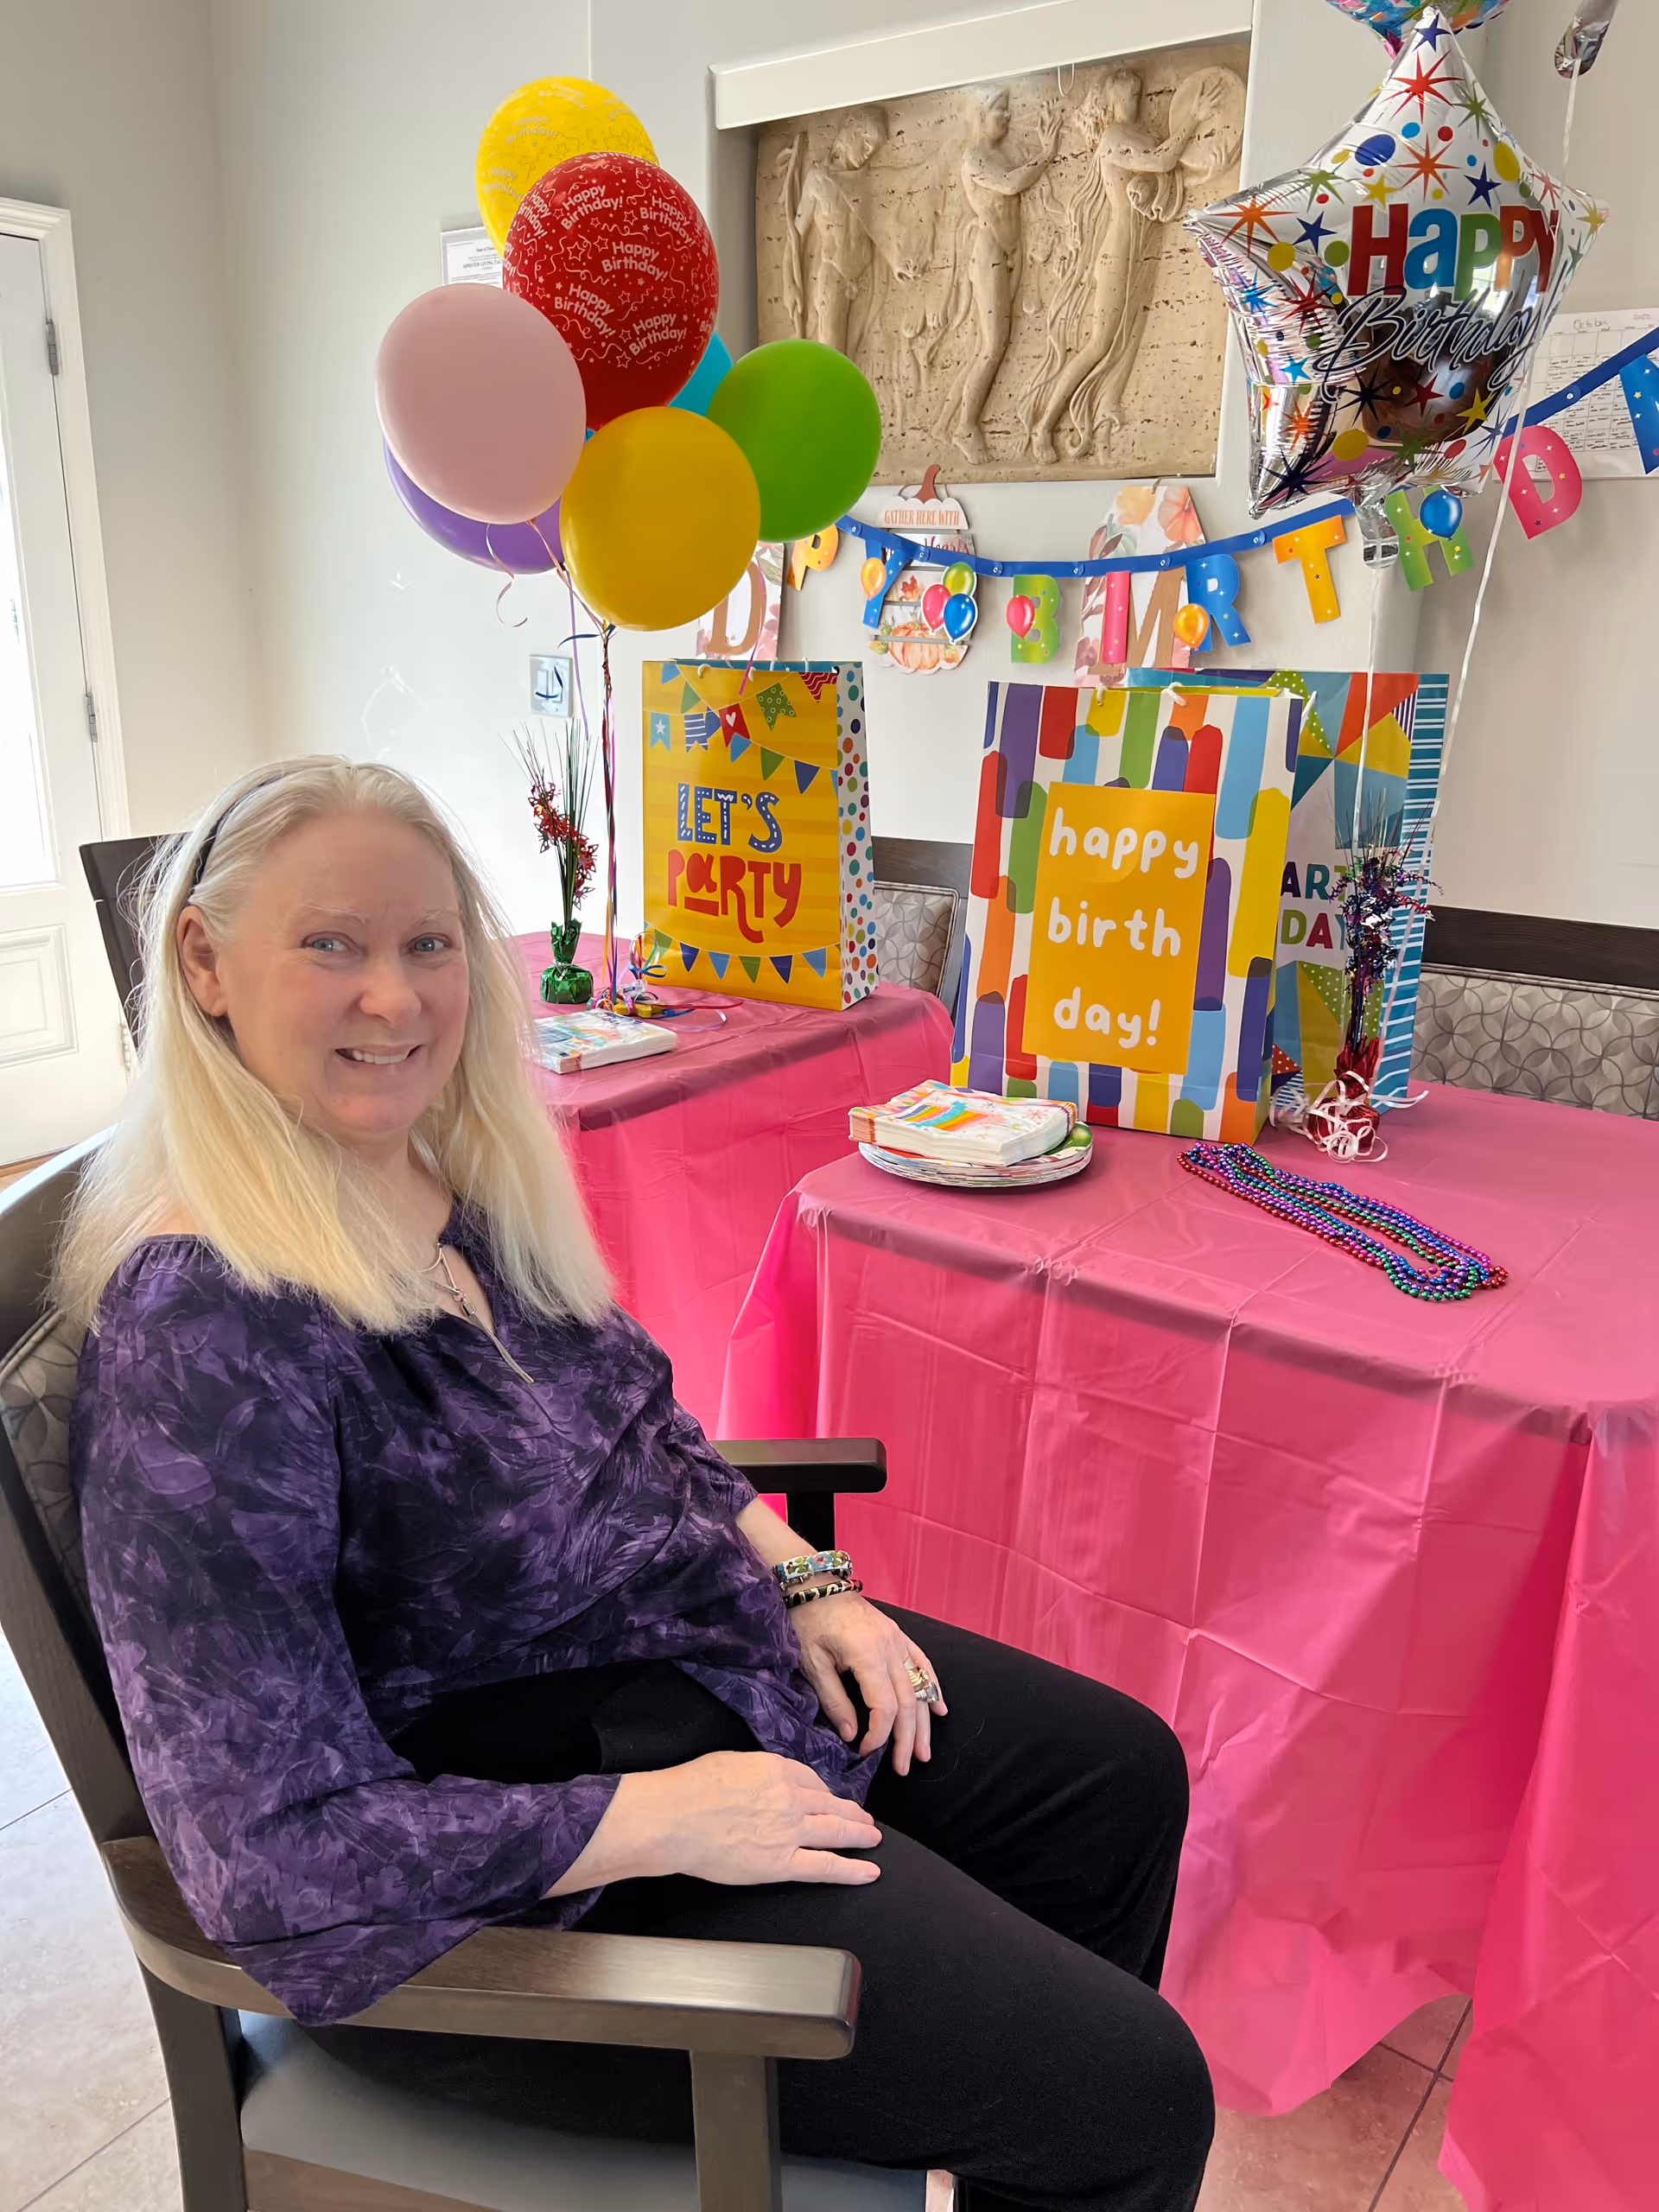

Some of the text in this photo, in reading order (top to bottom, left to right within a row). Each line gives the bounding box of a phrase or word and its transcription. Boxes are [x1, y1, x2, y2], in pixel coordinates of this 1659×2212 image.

[528, 191, 552, 219] Happy
[560, 195, 623, 231] Birthday!
[562, 185, 607, 212] Happy
[651, 195, 690, 226] Happy
[639, 207, 696, 248] Birthday!
[612, 241, 659, 262] Happy
[601, 257, 669, 283] Birthday!
[568, 283, 615, 317] Happy
[554, 296, 617, 340] Birthday!
[632, 312, 677, 335] Happy
[628, 327, 688, 356] Birthday!
[884, 510, 960, 526] GATHER HERE WITH
[677, 782, 784, 855] LET'S
[1049, 806, 1199, 880] happy
[1047, 896, 1182, 958] birth
[1052, 986, 1161, 1049] day!
